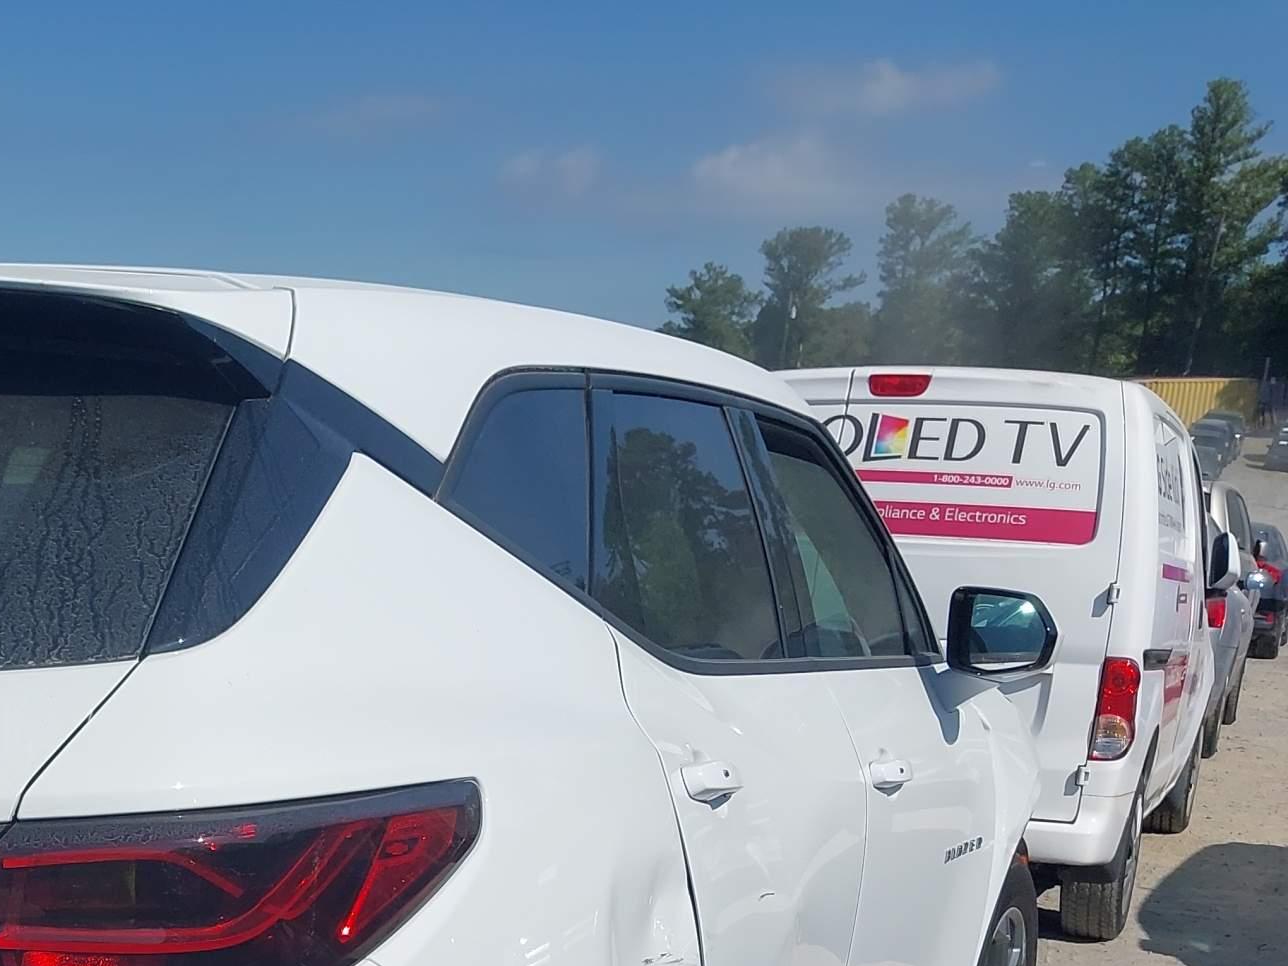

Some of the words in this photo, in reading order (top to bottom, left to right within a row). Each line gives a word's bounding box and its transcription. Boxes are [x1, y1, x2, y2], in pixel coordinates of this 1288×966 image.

[822, 413, 986, 462] OLED
[1004, 419, 1091, 467] TV
[933, 474, 1010, 486] 1-800-243-0000
[1015, 479, 1081, 491] www.lg.com
[929, 507, 940, 521] &
[945, 507, 1027, 525] Electronics
